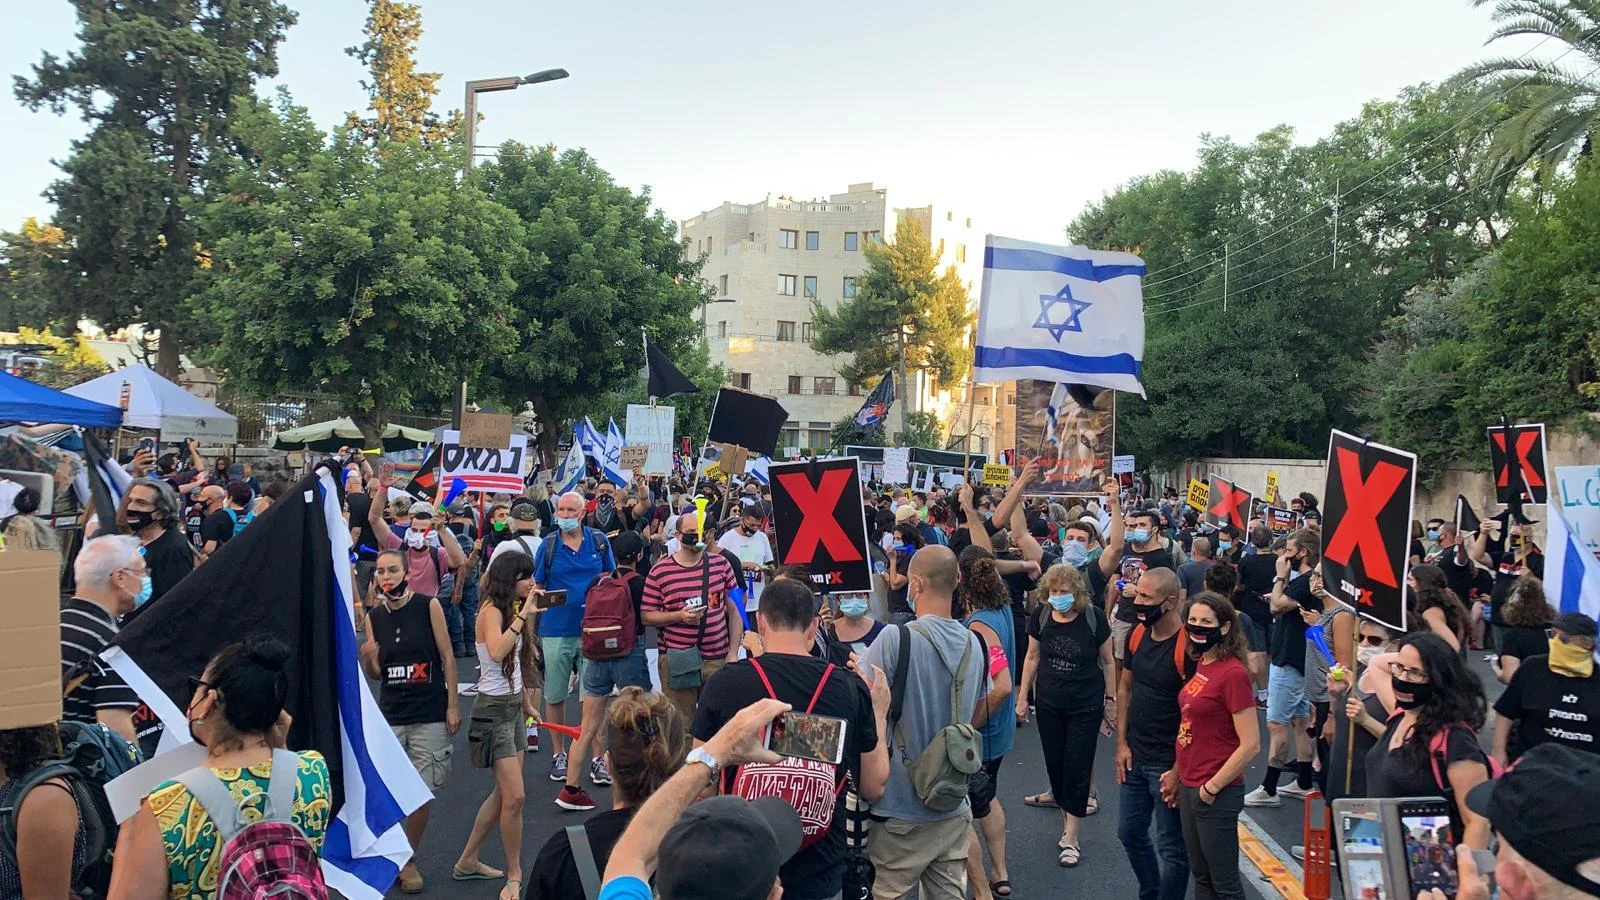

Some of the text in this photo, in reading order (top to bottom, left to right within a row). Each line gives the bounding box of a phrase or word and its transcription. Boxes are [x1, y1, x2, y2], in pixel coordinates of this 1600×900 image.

[443, 444, 522, 474] נמאס
[387, 666, 406, 679] מצב
[1561, 694, 1579, 704] לא
